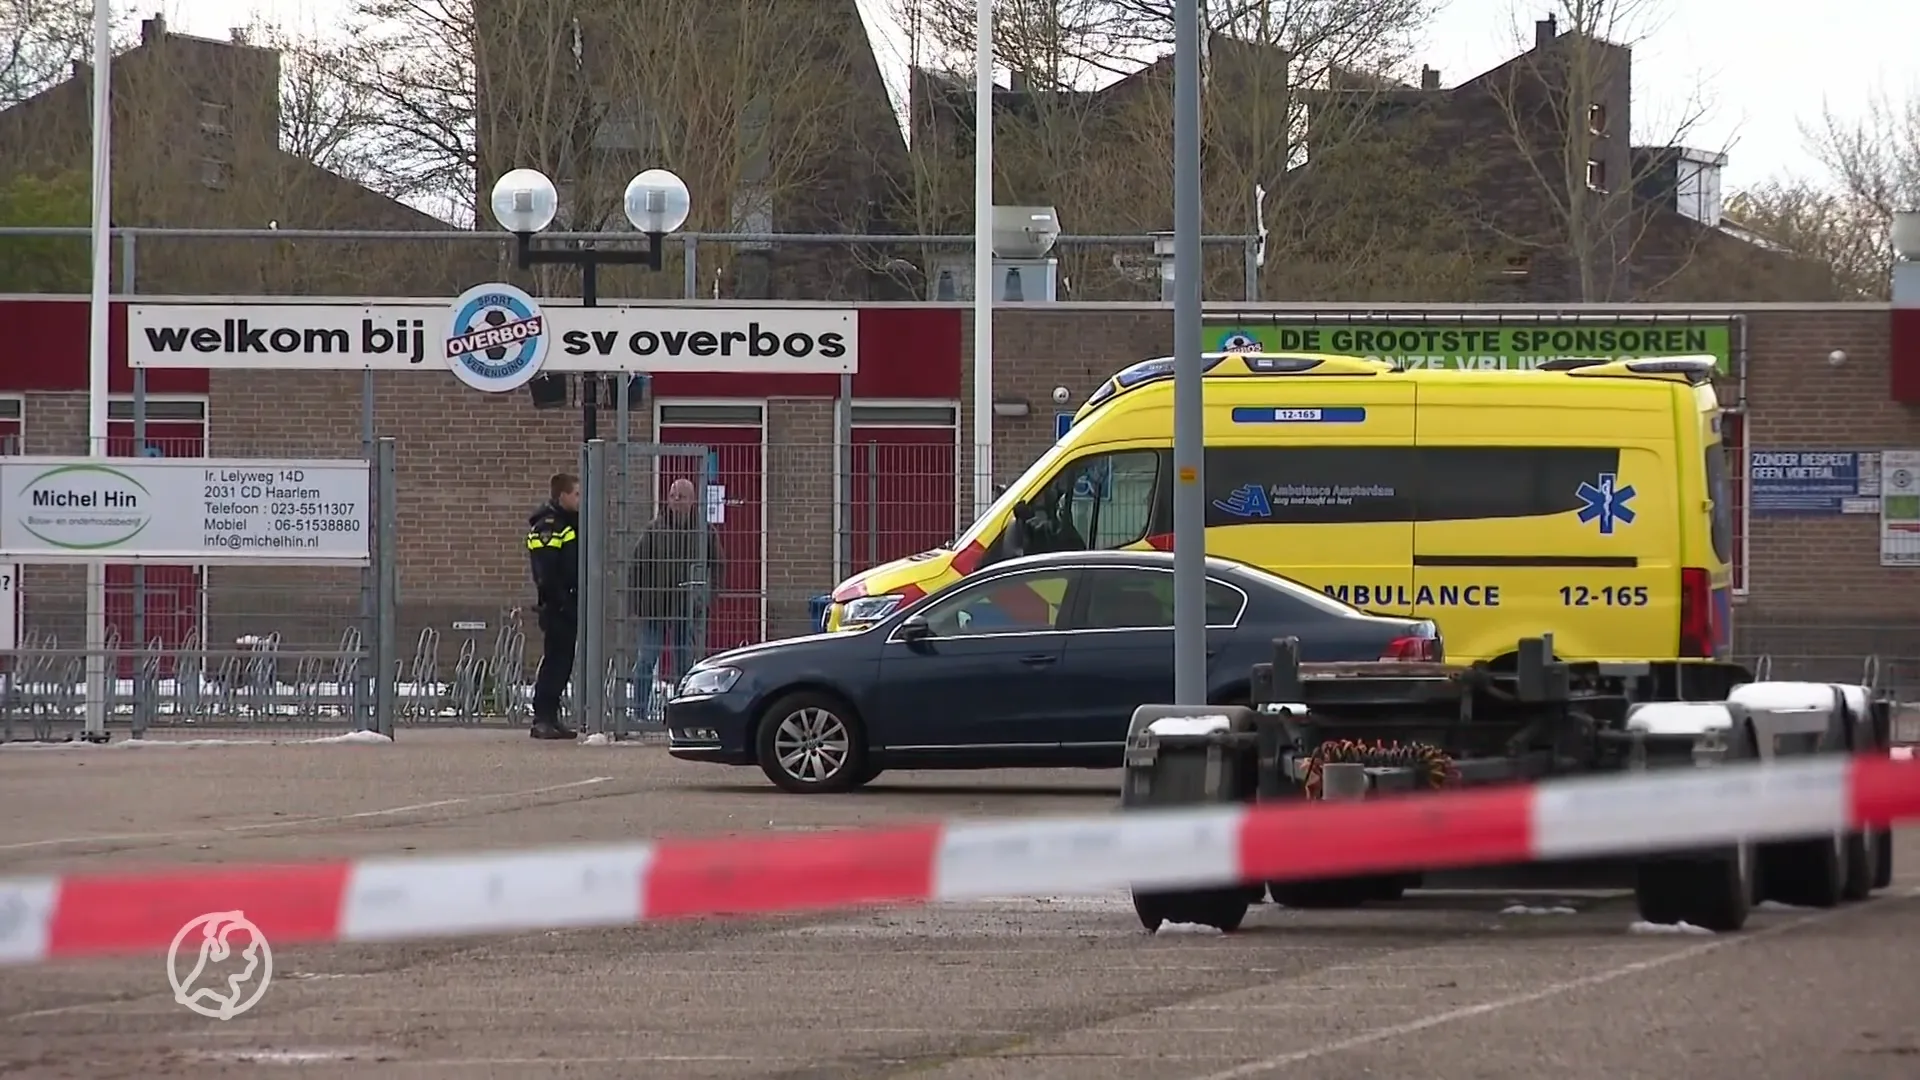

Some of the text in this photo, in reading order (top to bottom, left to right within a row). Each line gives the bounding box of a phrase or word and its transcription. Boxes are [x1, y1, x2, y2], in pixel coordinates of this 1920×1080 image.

[478, 295, 513, 306] SPORT
[144, 319, 424, 364] welkom bij
[448, 320, 540, 355] OVERBOS
[562, 322, 846, 358] sv overbos
[1280, 329, 1321, 351] DE
[1332, 329, 1500, 352] GROOTSTE
[1511, 329, 1707, 352] SPONSOREN
[466, 359, 524, 378] VERENIGING
[1281, 410, 1316, 420] 12-165
[1752, 453, 1853, 466] ZONDER RESPECT
[204, 470, 305, 485] Ir. Lelyweg 14D
[1752, 467, 1783, 479] GEEN
[204, 485, 320, 499] 2031 CD Haarlem
[1270, 484, 1395, 497] Ambulance Amsterdam
[33, 490, 137, 508] Michel Hin
[204, 502, 259, 514] Telefoon
[271, 503, 355, 516] 023-5511307
[204, 518, 247, 531] Mobiel
[274, 519, 360, 532] 06-51538880
[204, 534, 319, 550] info@michelhin.nl
[1324, 585, 1648, 606] MBULANCE 12-165
